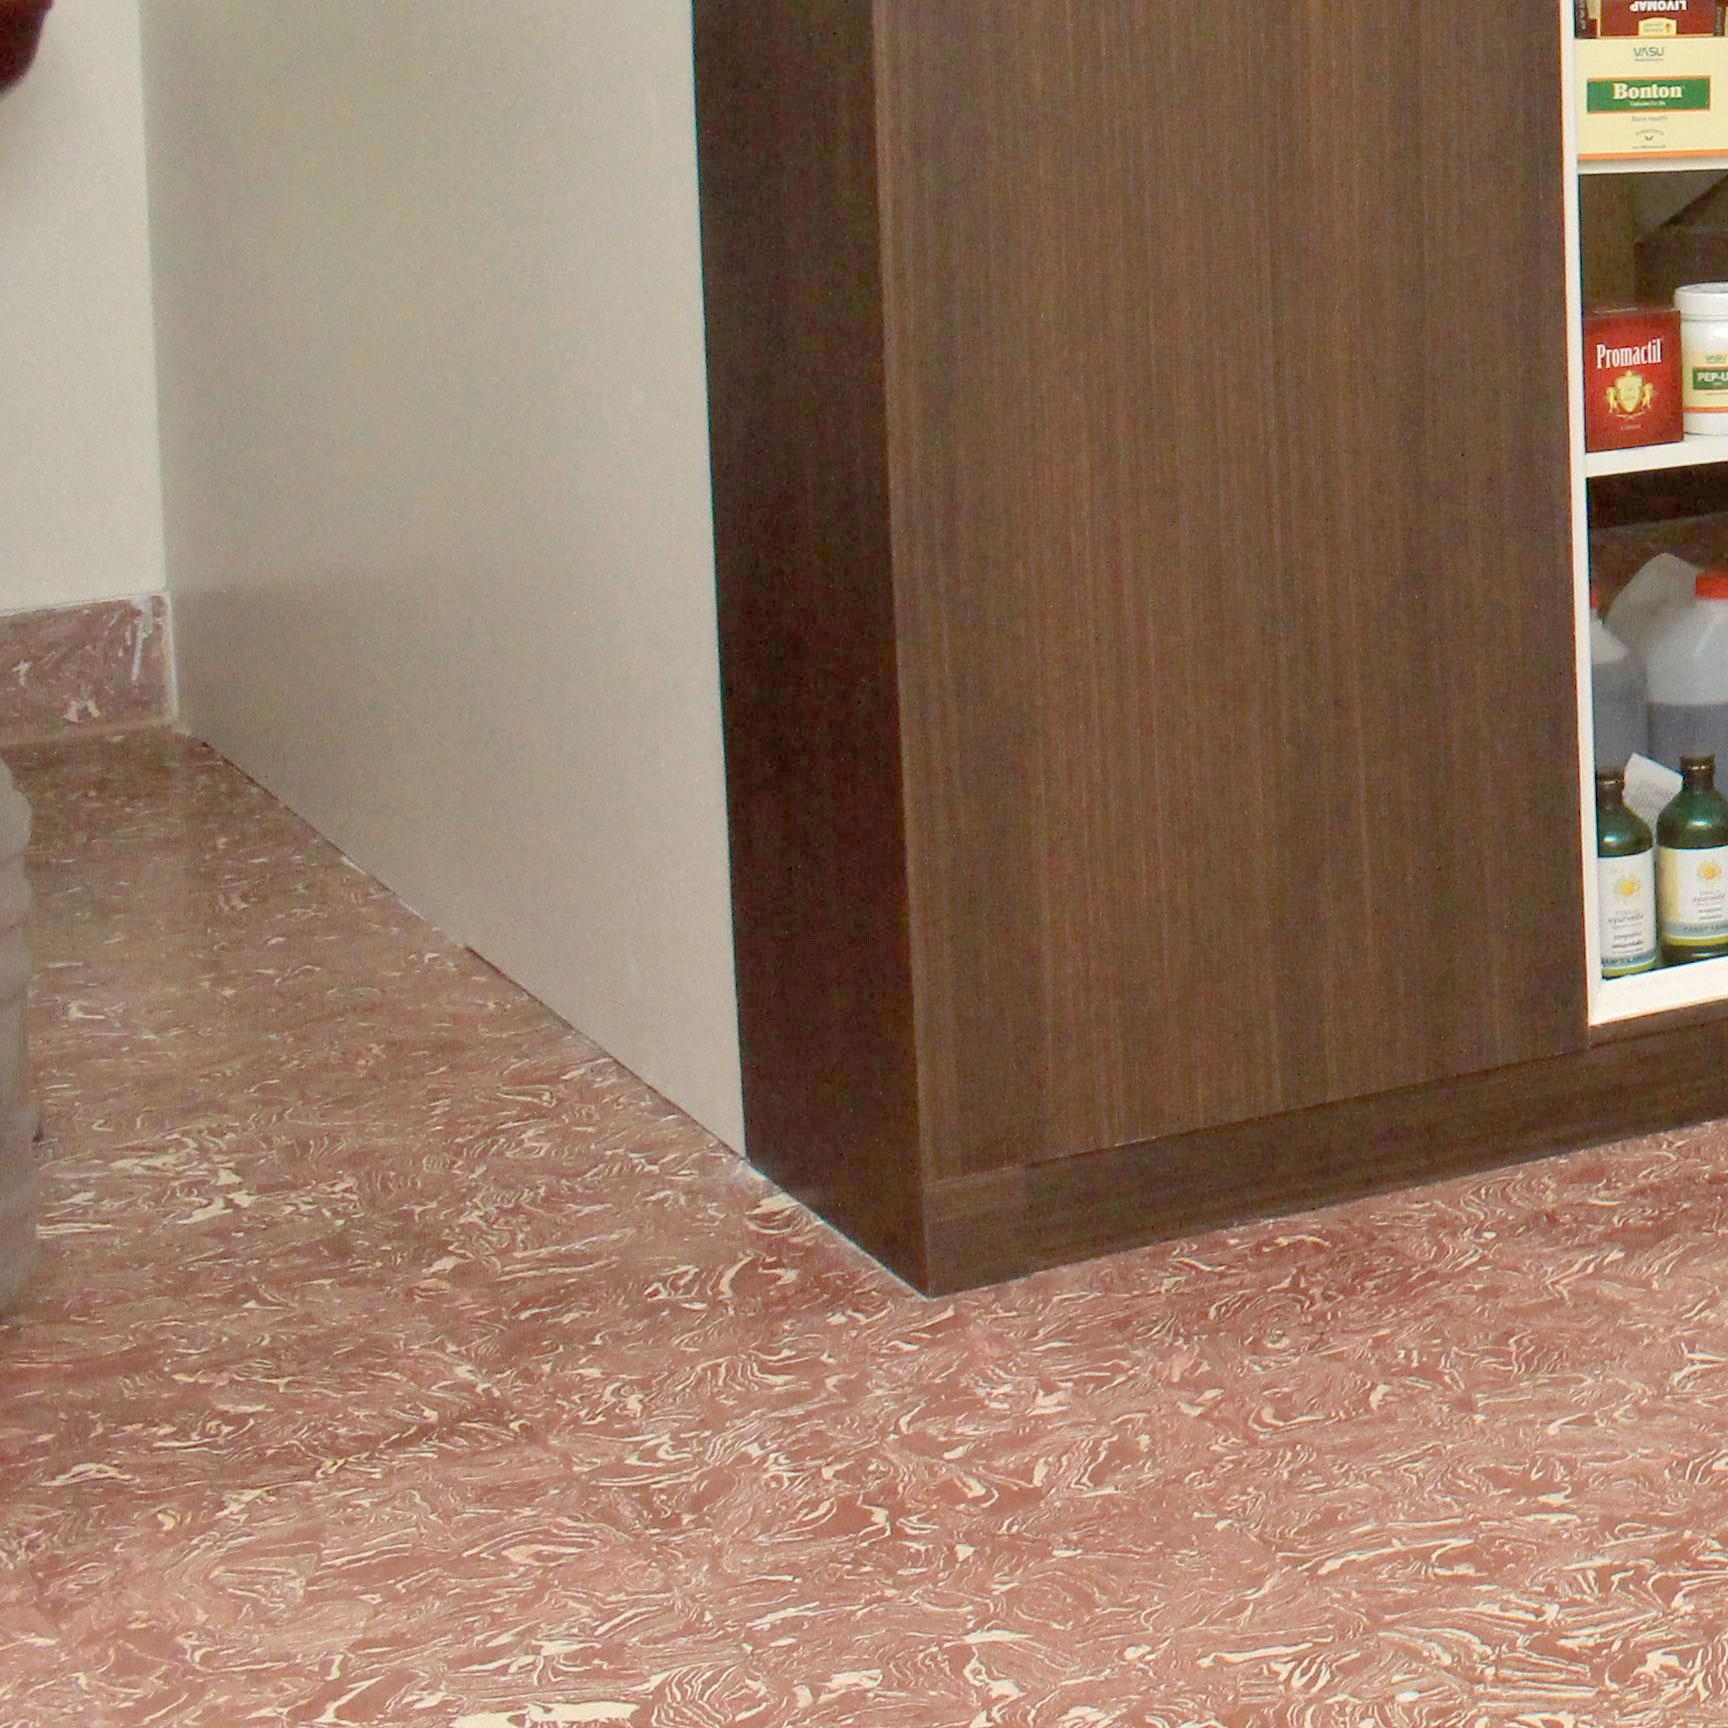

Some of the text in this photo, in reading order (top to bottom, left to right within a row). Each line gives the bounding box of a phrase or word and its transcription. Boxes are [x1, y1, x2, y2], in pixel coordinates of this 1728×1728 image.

[1629, 0, 1687, 12] LIVOMAP
[1633, 47, 1666, 57] VASU
[1612, 82, 1684, 100] Bonton
[1596, 338, 1662, 369] Promactil
